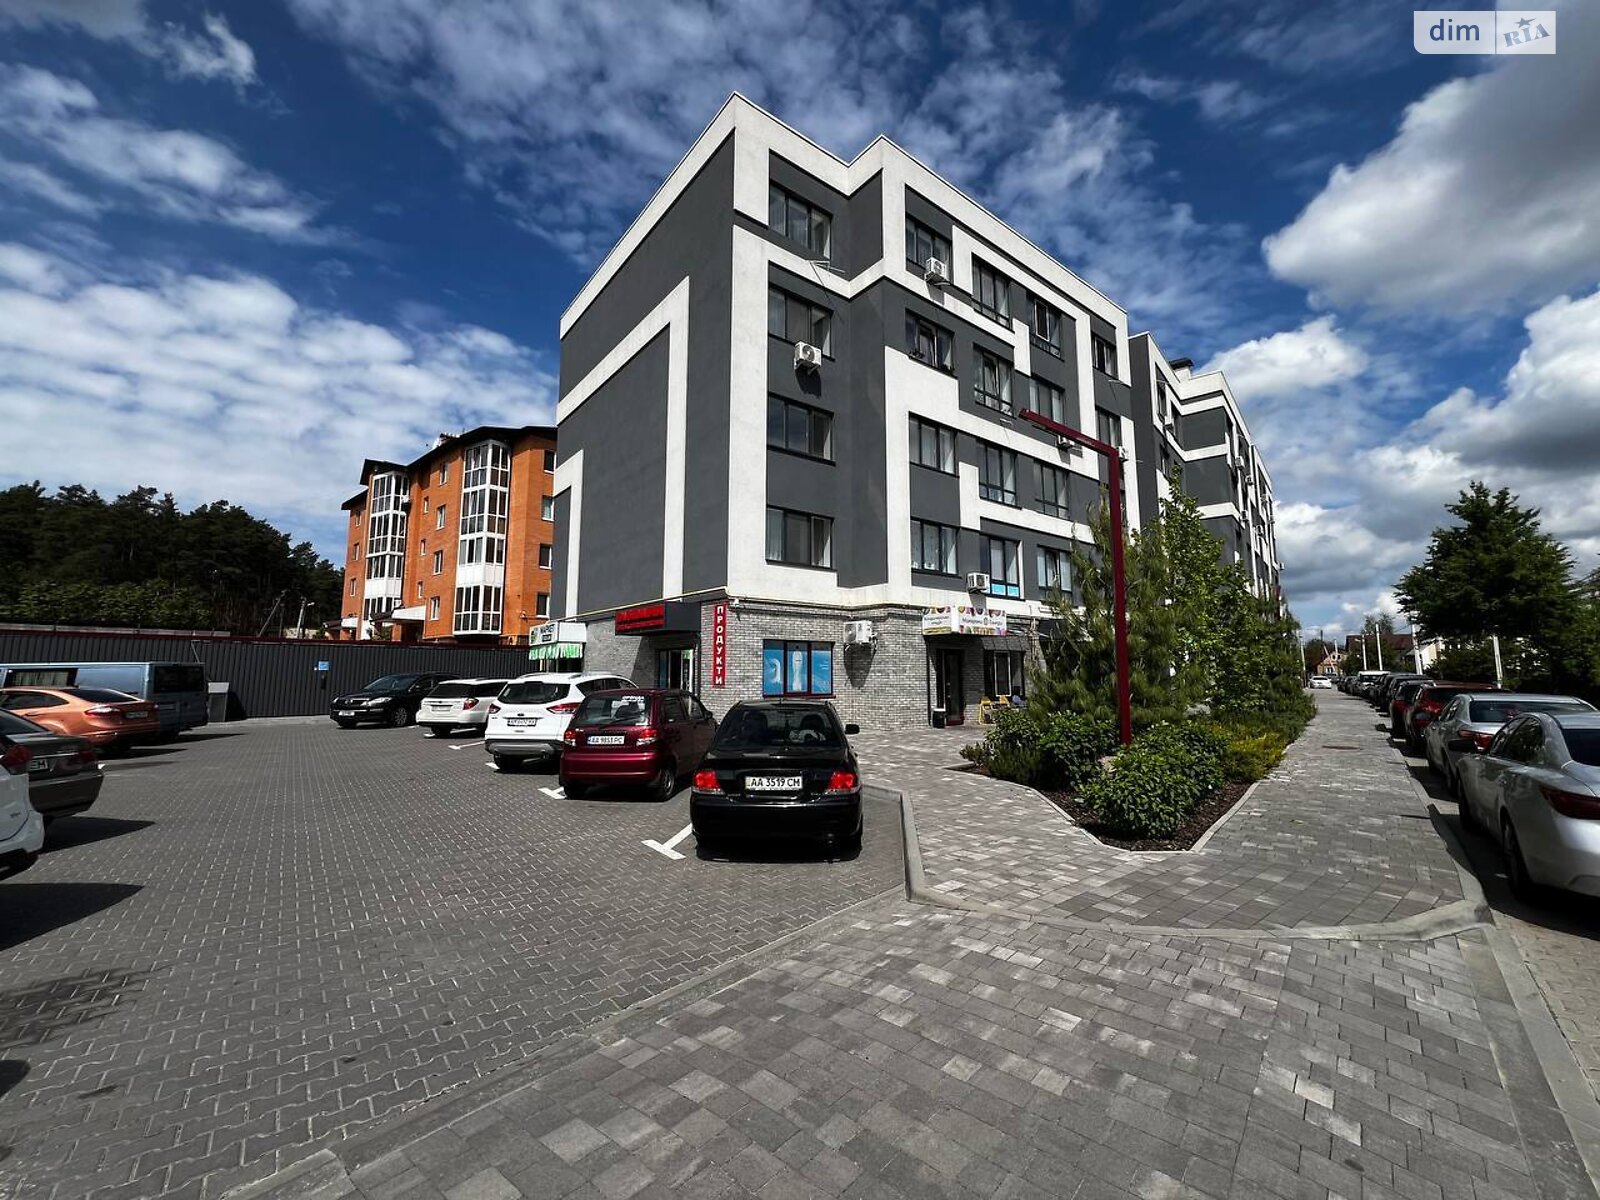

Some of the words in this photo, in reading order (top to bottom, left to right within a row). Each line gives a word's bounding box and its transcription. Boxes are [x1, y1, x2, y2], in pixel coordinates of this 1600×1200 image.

[715, 605, 725, 685] ПРОДУКТИ
[750, 778, 764, 787] AA
[765, 778, 786, 787] 3519
[787, 778, 801, 787] CM
